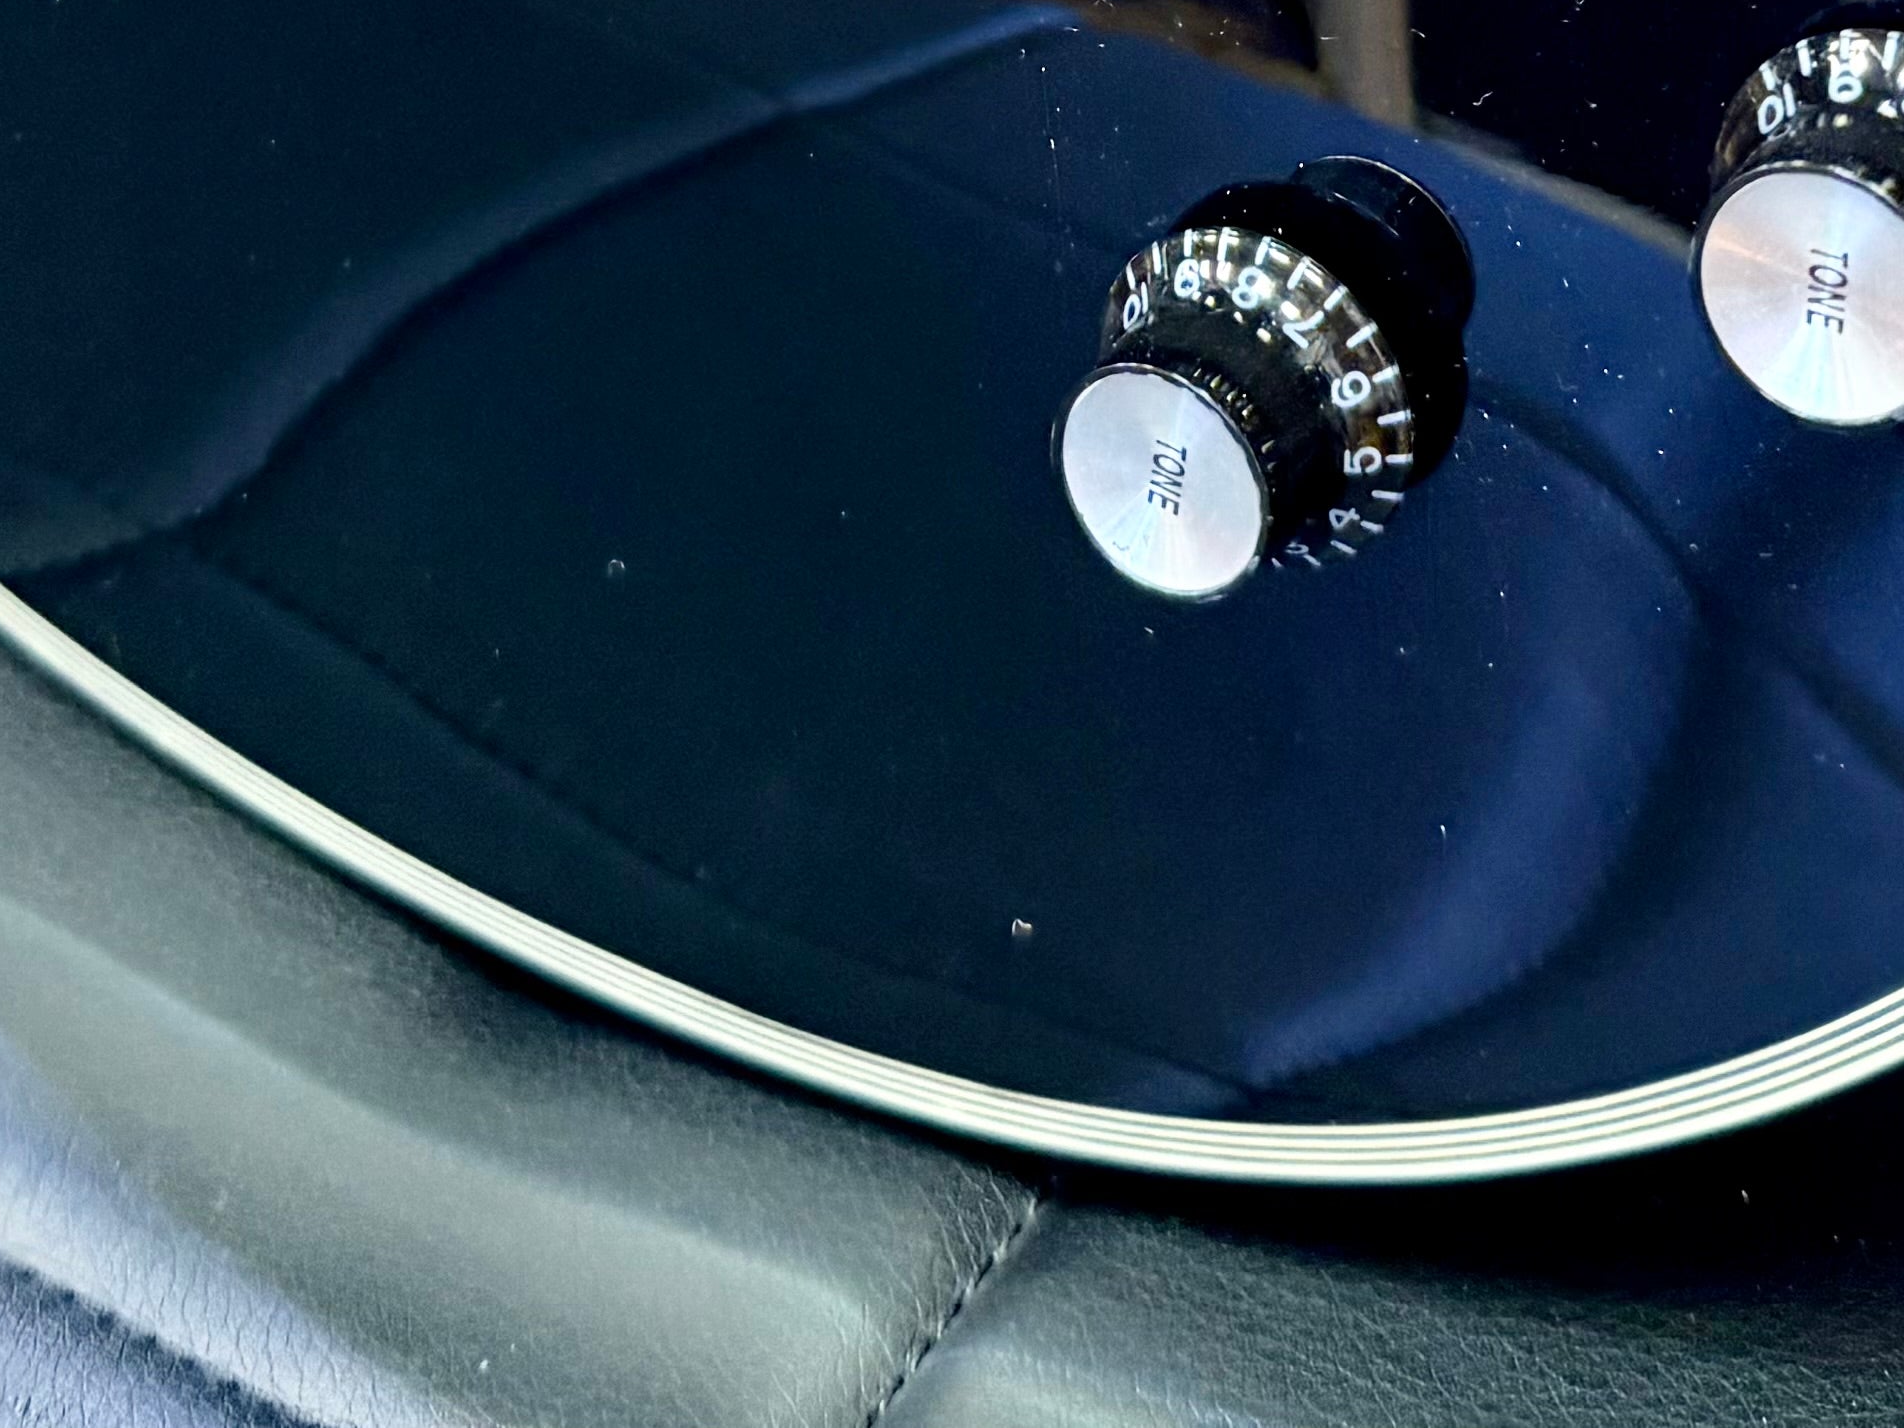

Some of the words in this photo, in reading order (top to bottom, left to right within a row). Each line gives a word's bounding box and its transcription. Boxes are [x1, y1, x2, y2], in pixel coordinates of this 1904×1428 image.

[1231, 266, 1264, 309] 8
[1805, 247, 1850, 335] TONE
[1283, 311, 1325, 349] 7
[1331, 370, 1372, 408] 6
[1146, 439, 1188, 516] TONE
[1344, 447, 1383, 476] 5
[1329, 507, 1360, 530] 4
